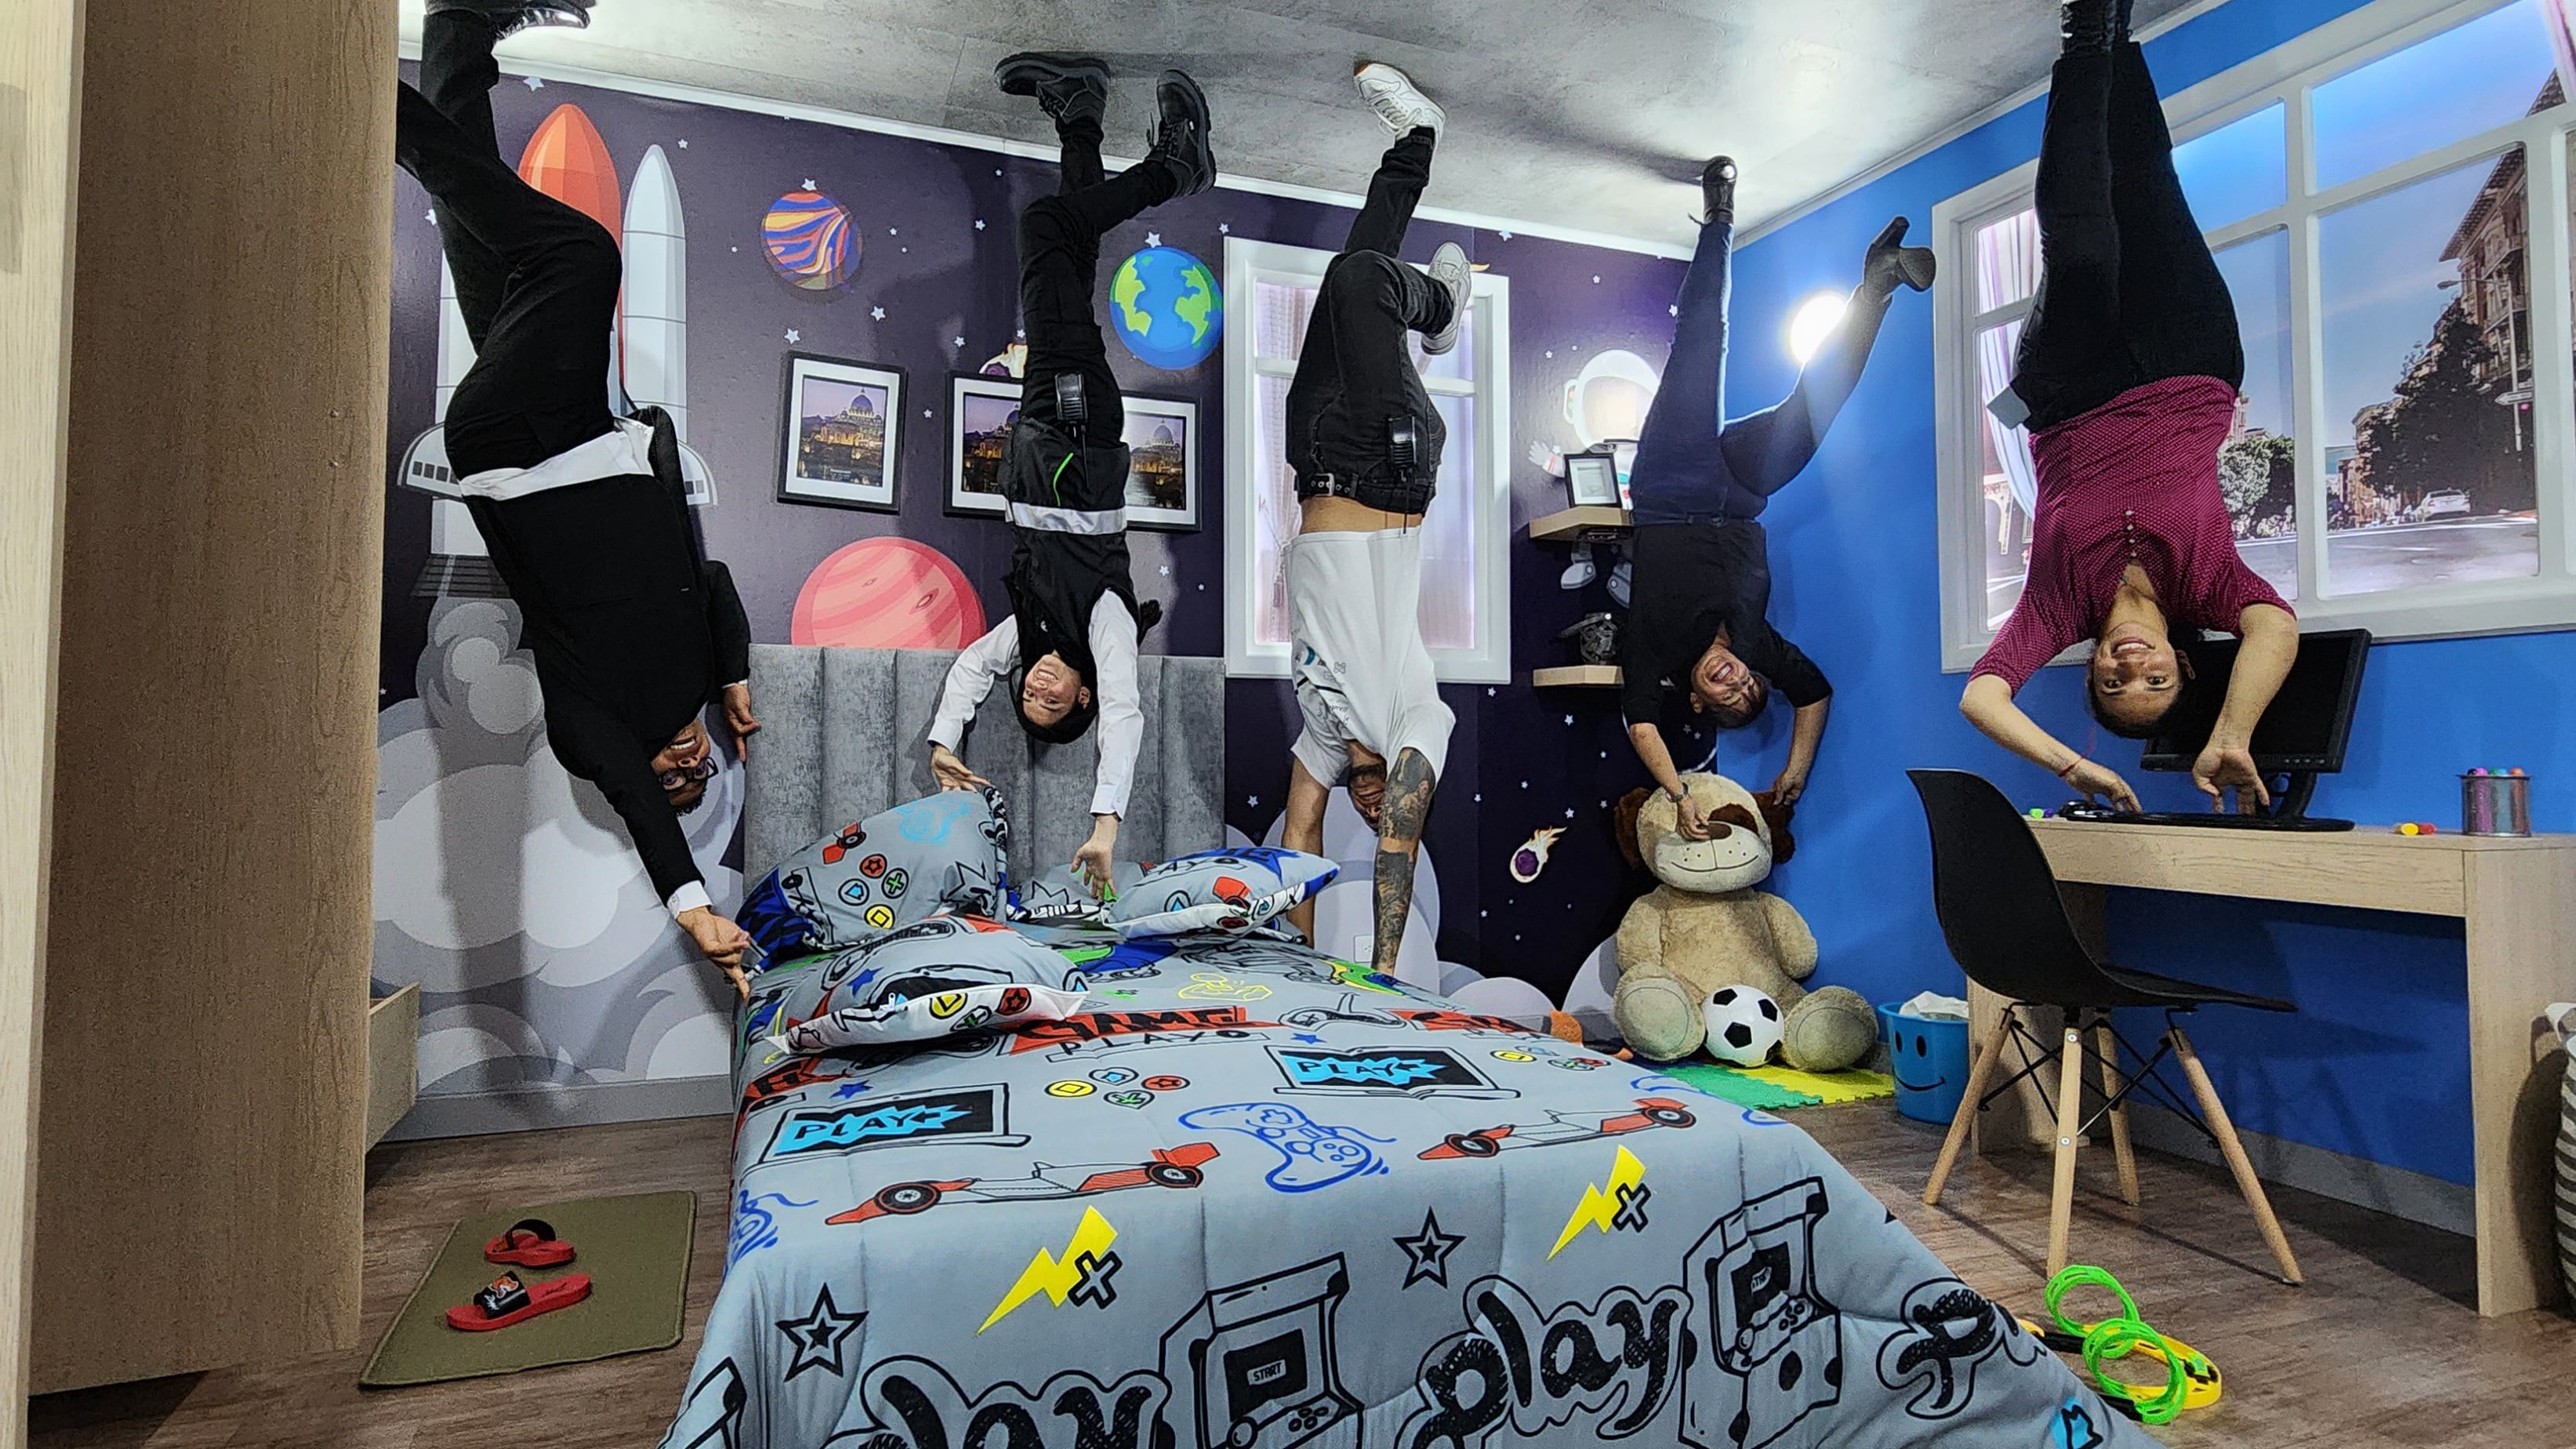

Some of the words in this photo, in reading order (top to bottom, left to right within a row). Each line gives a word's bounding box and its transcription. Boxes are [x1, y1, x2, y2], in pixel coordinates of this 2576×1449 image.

[1297, 1061, 1395, 1078] PLAY
[793, 1112, 914, 1140] PLAY
[1253, 1362, 1283, 1382] START
[1411, 1290, 1680, 1449] play
